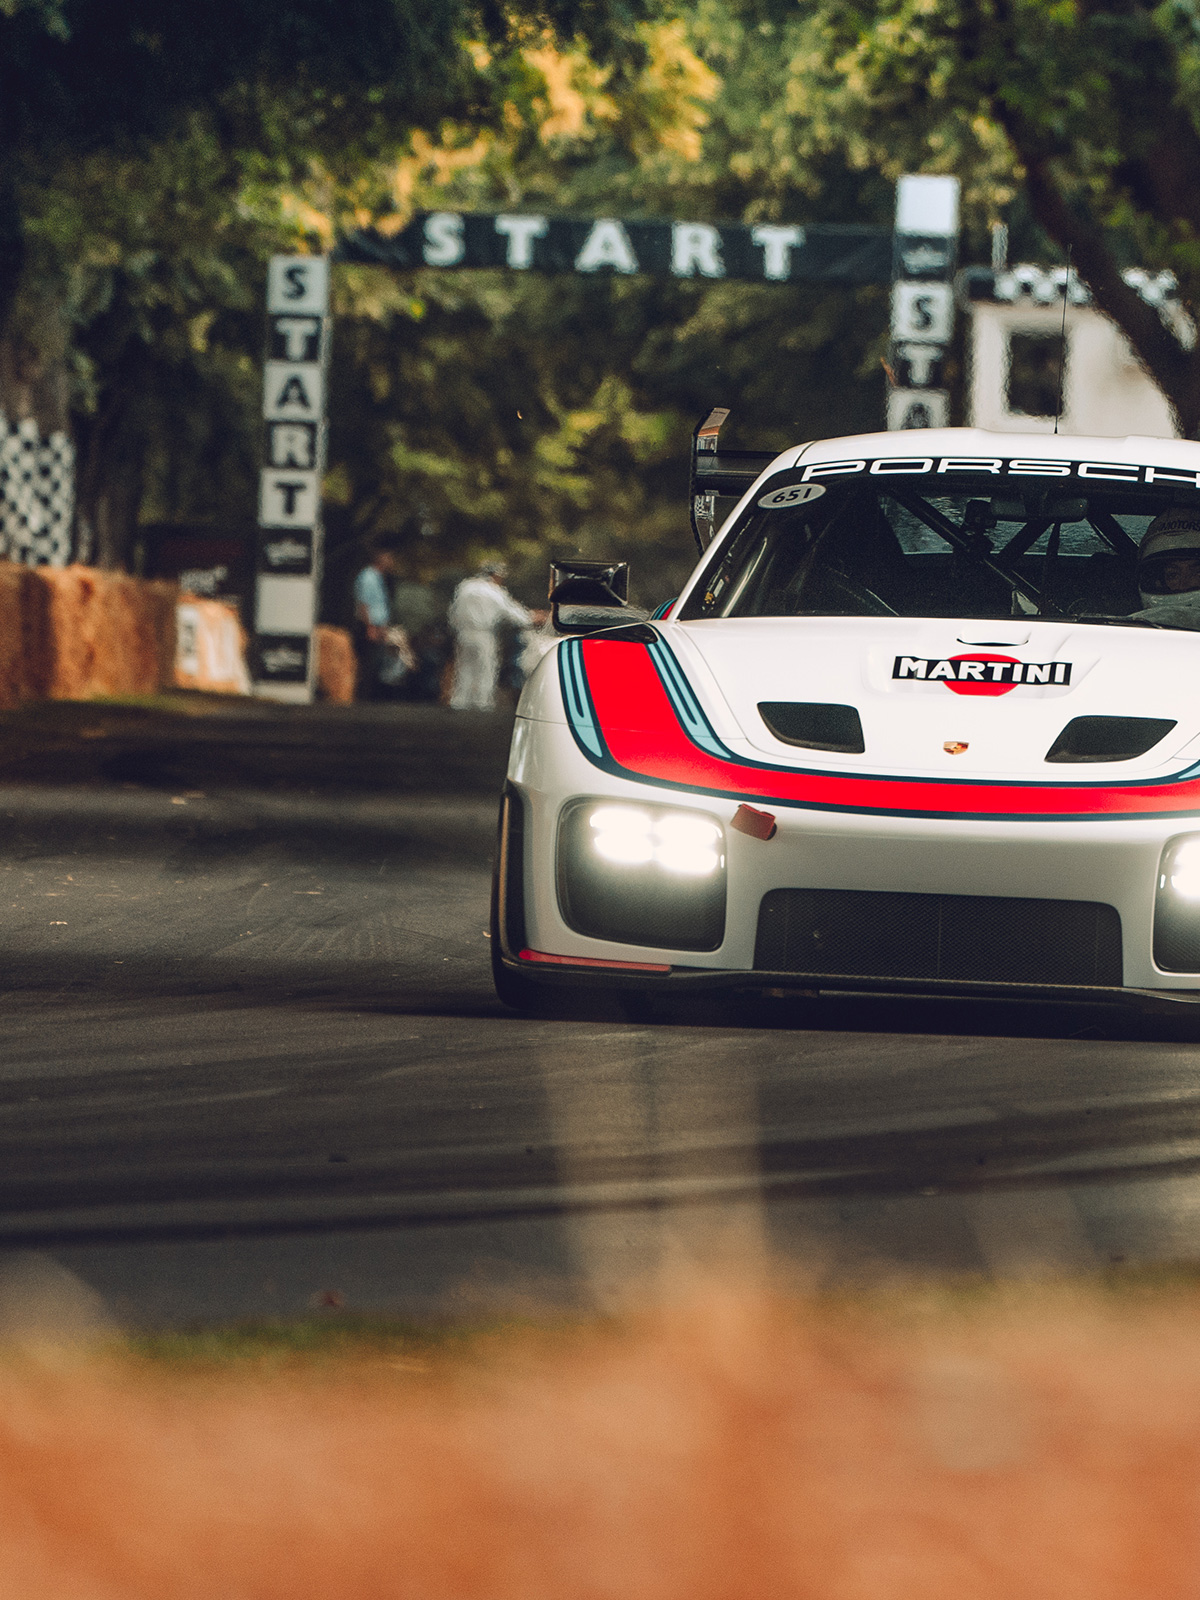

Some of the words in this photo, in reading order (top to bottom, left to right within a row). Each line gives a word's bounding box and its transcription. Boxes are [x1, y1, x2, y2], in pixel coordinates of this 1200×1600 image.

[423, 212, 805, 281] START
[273, 265, 318, 516] START
[772, 487, 812, 504] 651
[898, 656, 1067, 684] MARTINI
